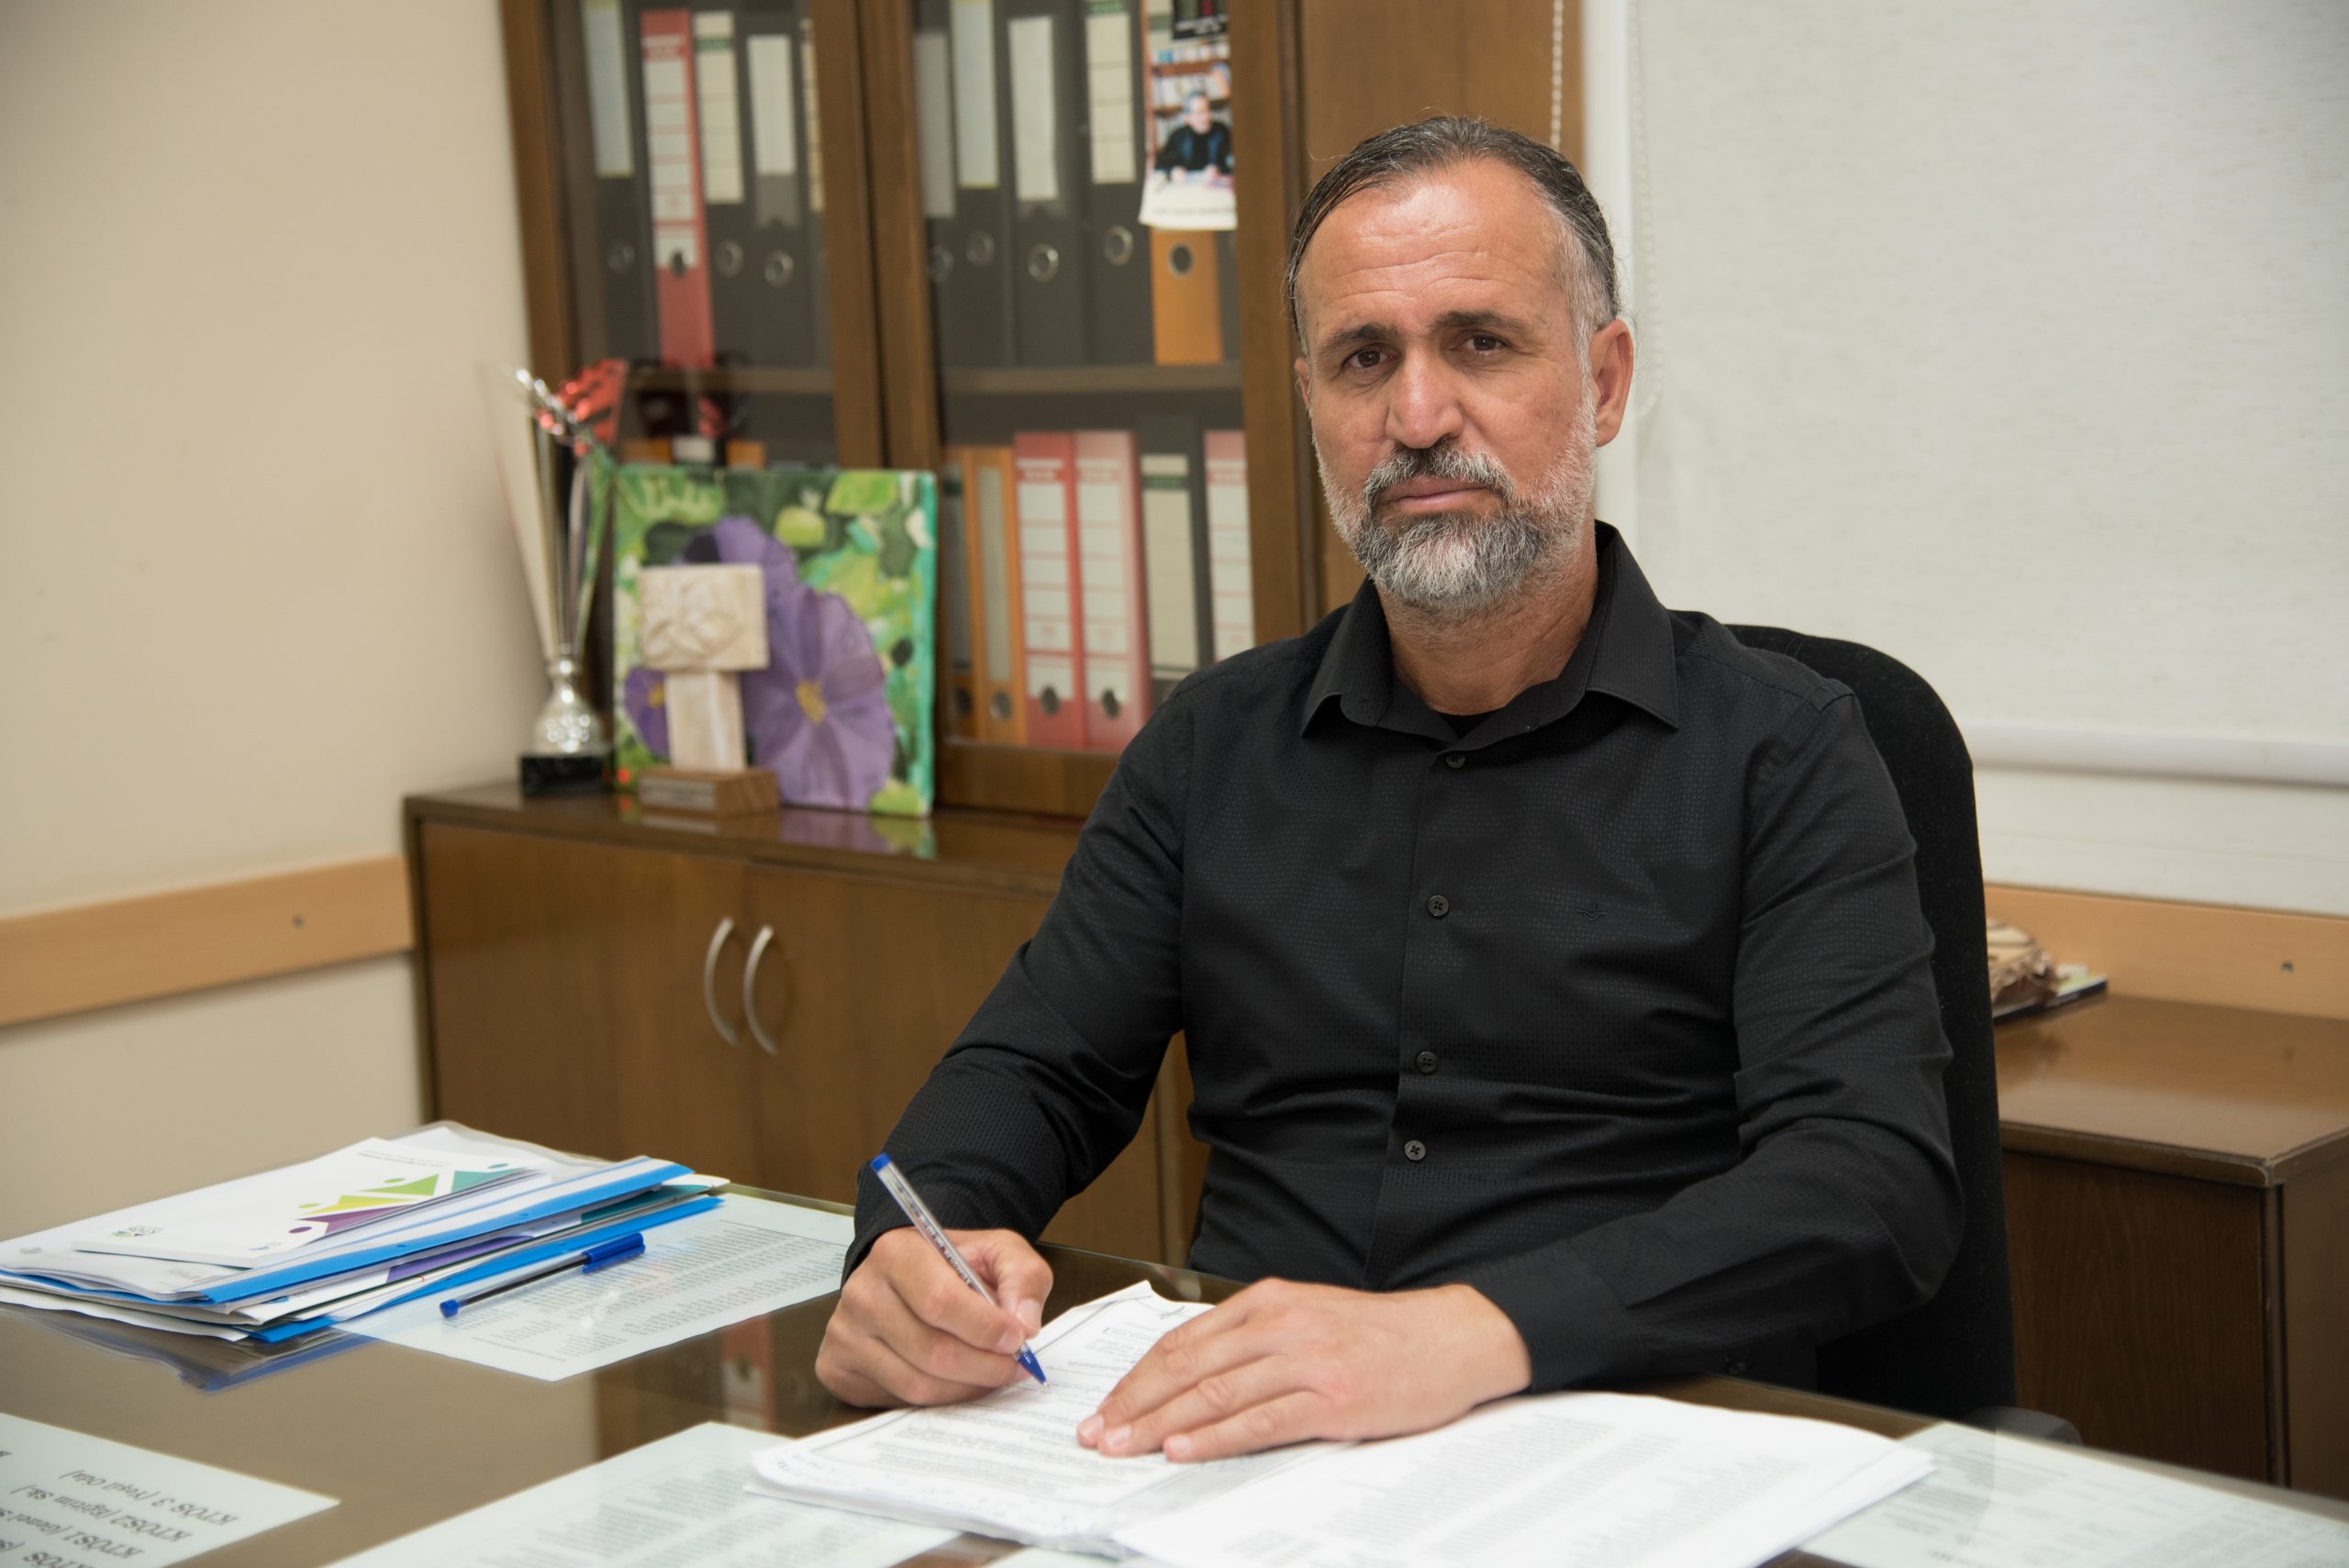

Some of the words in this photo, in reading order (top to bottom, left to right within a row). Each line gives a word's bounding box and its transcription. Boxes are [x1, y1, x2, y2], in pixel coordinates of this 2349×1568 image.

[58, 1470, 106, 1485] Oda)
[150, 1497, 175, 1507] 3
[169, 1502, 239, 1526] KTÖS
[109, 1515, 194, 1541] KTÖS2
[61, 1531, 145, 1559] KTÖS1
